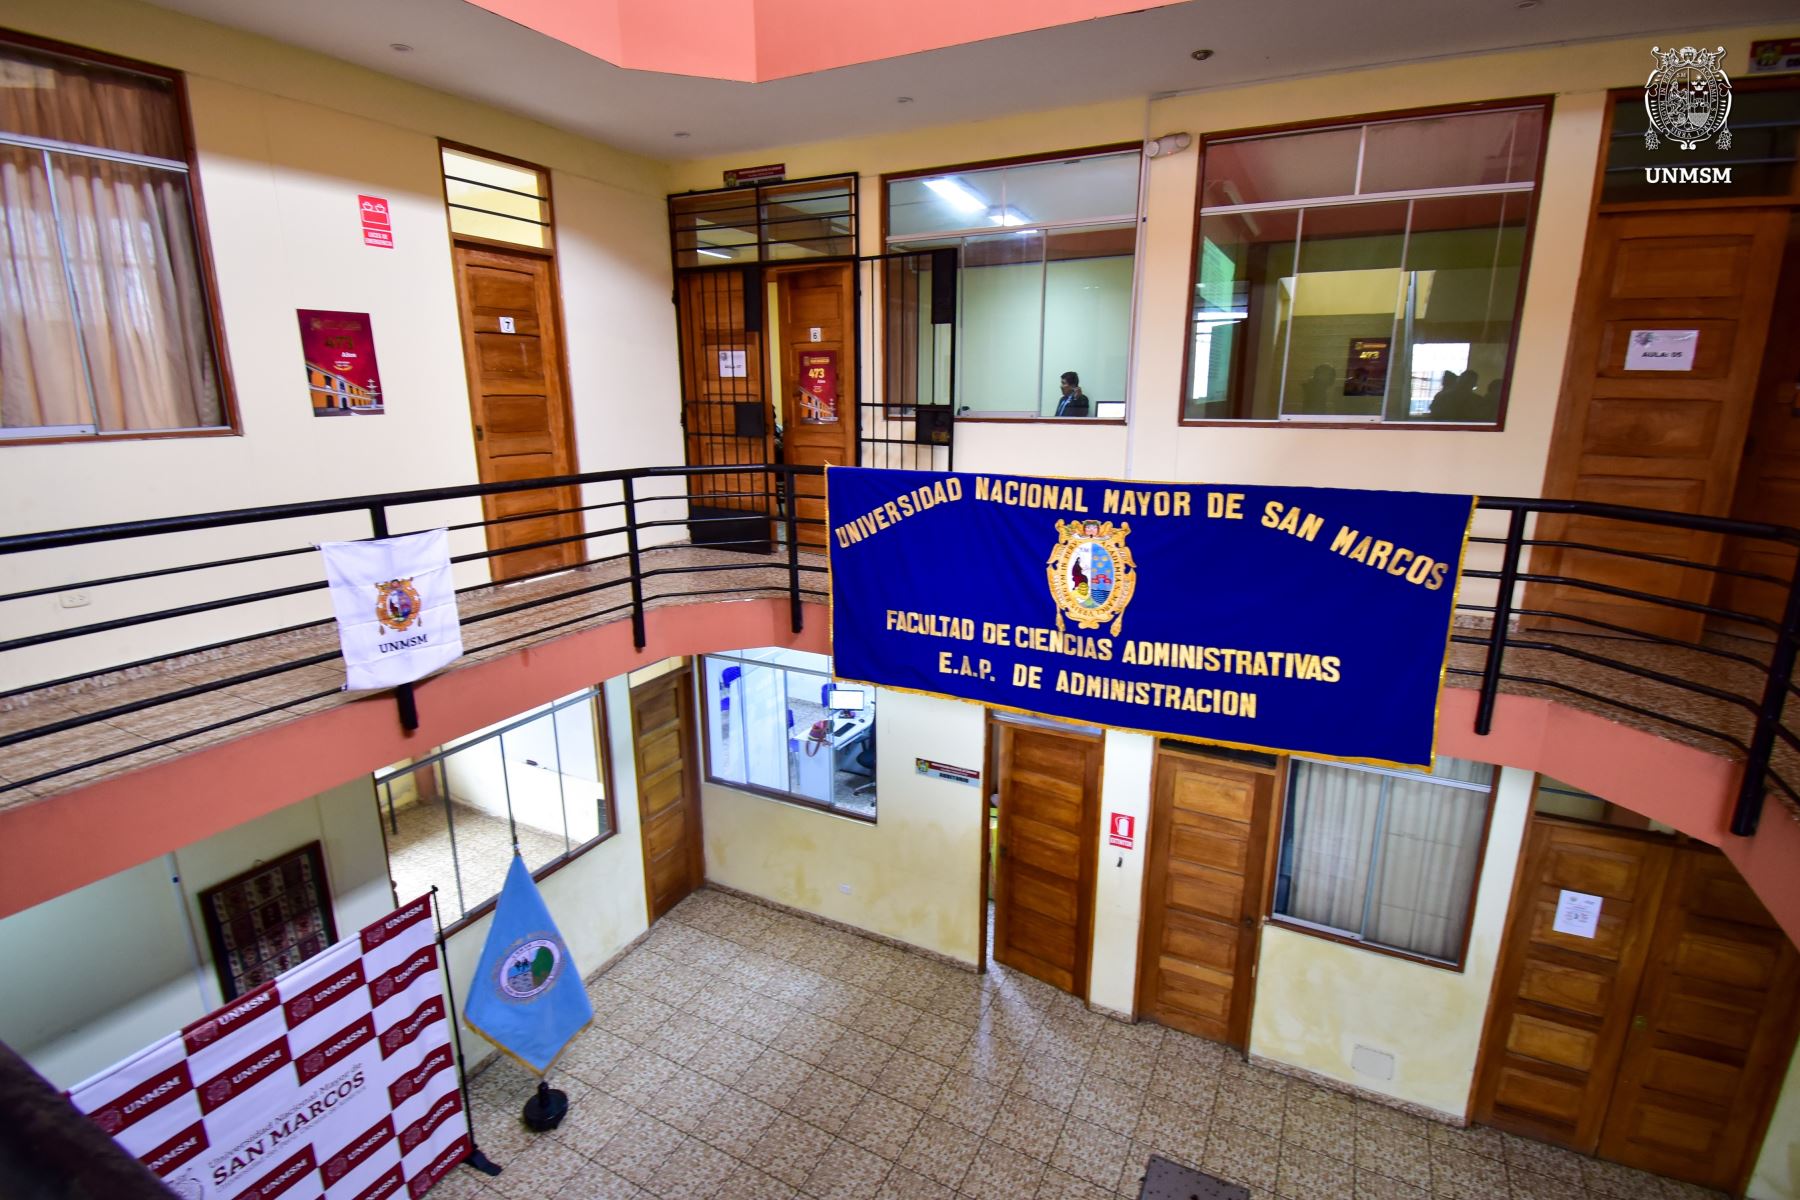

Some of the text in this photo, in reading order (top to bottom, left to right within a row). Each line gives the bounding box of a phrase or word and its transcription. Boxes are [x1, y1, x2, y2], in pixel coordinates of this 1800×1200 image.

[504, 321, 511, 330] 7
[808, 368, 825, 379] 473
[835, 476, 1448, 591] UNIVERSIDAD NACIONAL MAYOR DE SAN MARCOS
[378, 634, 429, 654] UNMSM
[886, 609, 1341, 682] FACULTAD DE CIENCIAS ADMINISTRATIVAS
[939, 651, 1257, 718] E.A.P. DE ADMINISTRACION
[385, 904, 424, 929] UNMSM
[395, 955, 430, 983] UNMSM
[314, 971, 359, 1002] UNMSM
[219, 992, 271, 1026] UNMSM
[404, 1006, 437, 1034] UNMSM
[324, 1025, 368, 1057] UNMSM
[232, 1049, 283, 1084] UNMSM
[413, 1053, 446, 1085] UNMSM
[124, 1076, 181, 1114] UNMSM
[213, 1139, 264, 1186] SAN
[269, 1071, 366, 1147] MARCOS
[423, 1099, 455, 1131] UNMSM
[348, 1127, 389, 1161] UNMSM
[261, 1158, 309, 1195] UNMSM
[431, 1145, 465, 1177] UNMSM
